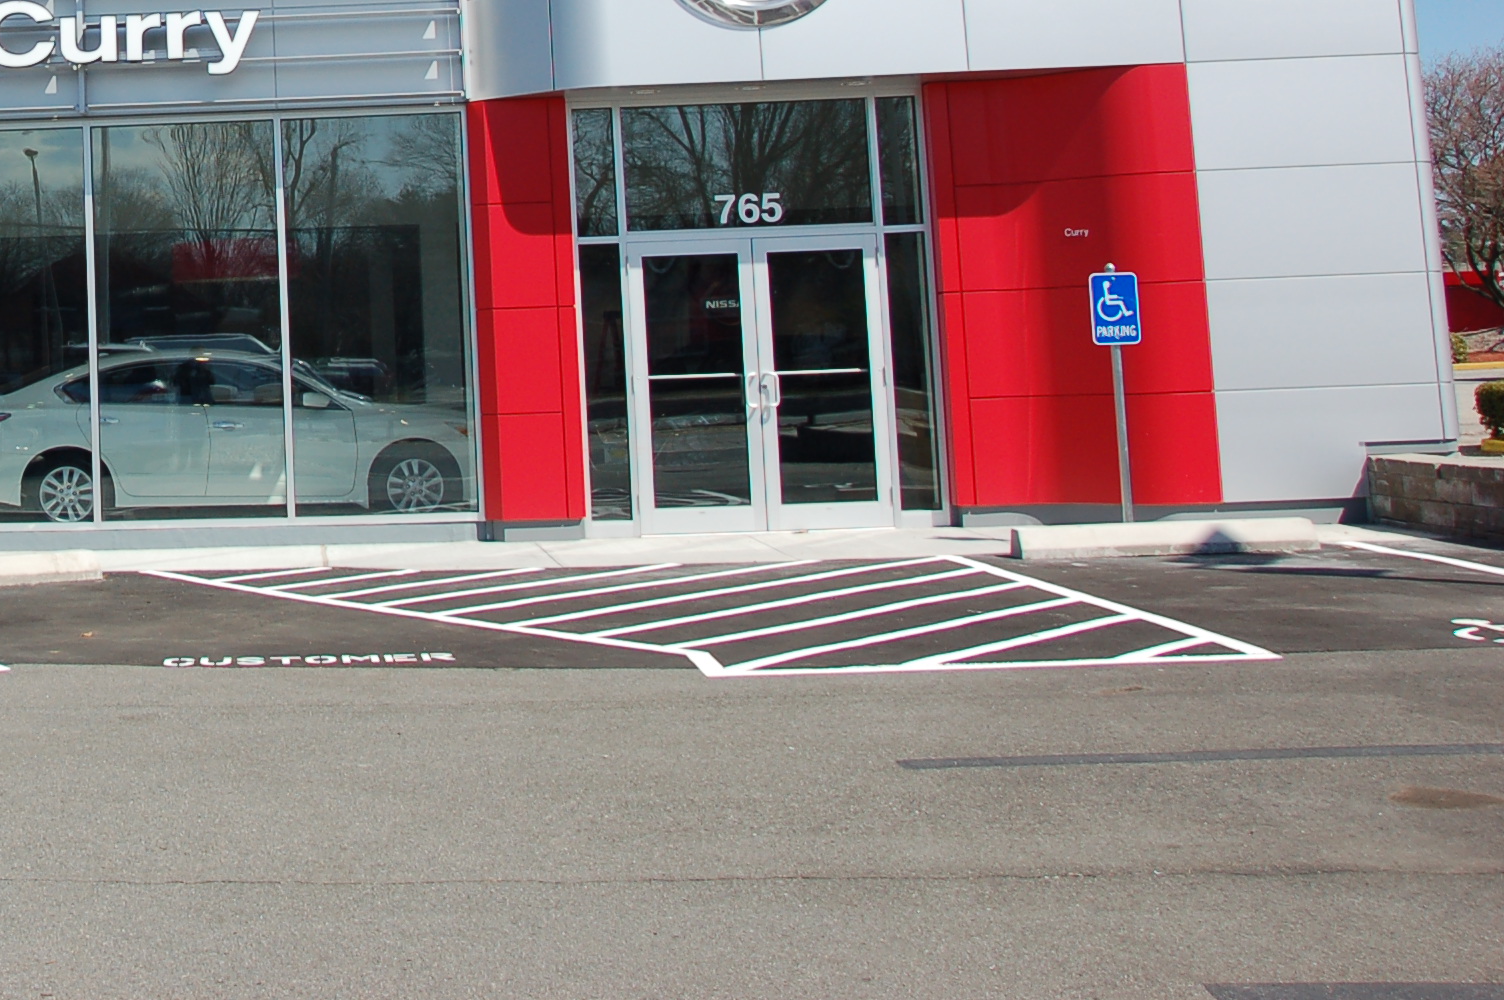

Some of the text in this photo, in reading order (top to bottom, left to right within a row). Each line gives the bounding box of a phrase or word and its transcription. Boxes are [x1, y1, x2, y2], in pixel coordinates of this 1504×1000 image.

[714, 192, 783, 224] 765
[1064, 227, 1089, 238] Curry
[705, 299, 740, 309] NISS
[1096, 324, 1137, 340] PARKING
[163, 652, 456, 667] CUSTOMER
